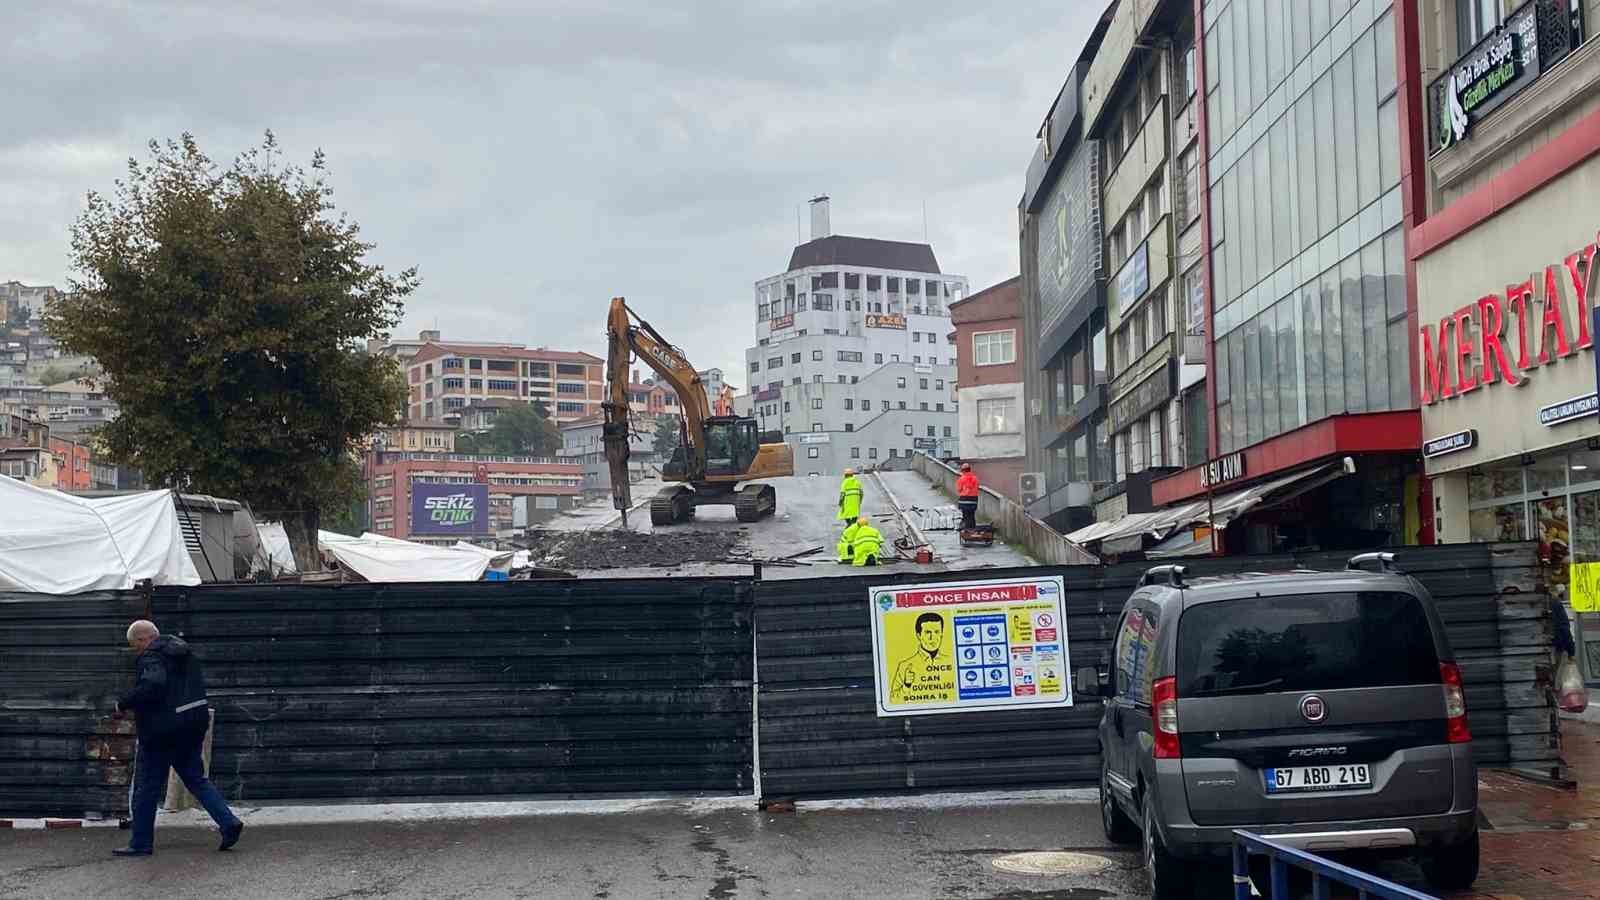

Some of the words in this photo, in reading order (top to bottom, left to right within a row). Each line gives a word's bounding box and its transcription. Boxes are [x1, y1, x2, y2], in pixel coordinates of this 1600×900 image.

[1420, 231, 1600, 406] MERTAY
[1223, 453, 1242, 481] AVM
[923, 592, 963, 604] ÖNCE
[967, 590, 1010, 601] İNSAN
[1276, 769, 1293, 786] 67
[1303, 766, 1330, 785] ABD
[1339, 765, 1367, 783] 219
